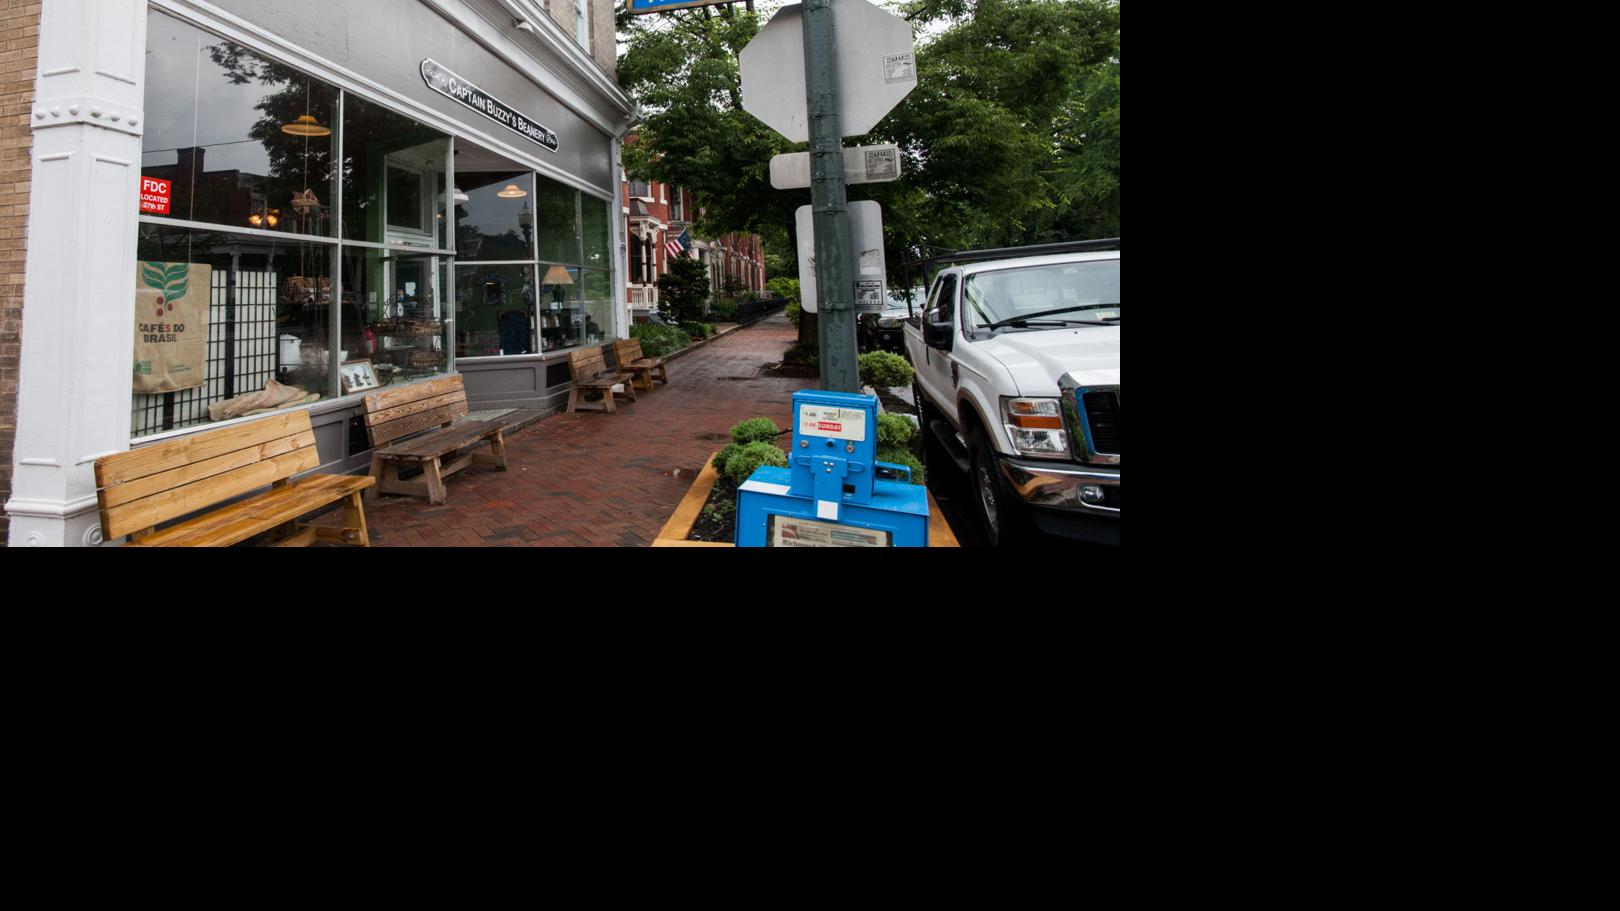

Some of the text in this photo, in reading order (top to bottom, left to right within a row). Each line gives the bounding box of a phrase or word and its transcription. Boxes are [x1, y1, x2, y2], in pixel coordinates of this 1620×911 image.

[448, 78, 546, 143] CAPTAIN BUZZY'S BEANERY
[143, 179, 167, 194] FDC
[140, 193, 169, 204] LOCATED
[138, 322, 185, 333] CAFÉS DO
[143, 334, 178, 343] BRASIL
[818, 422, 841, 431] SUNDAY
